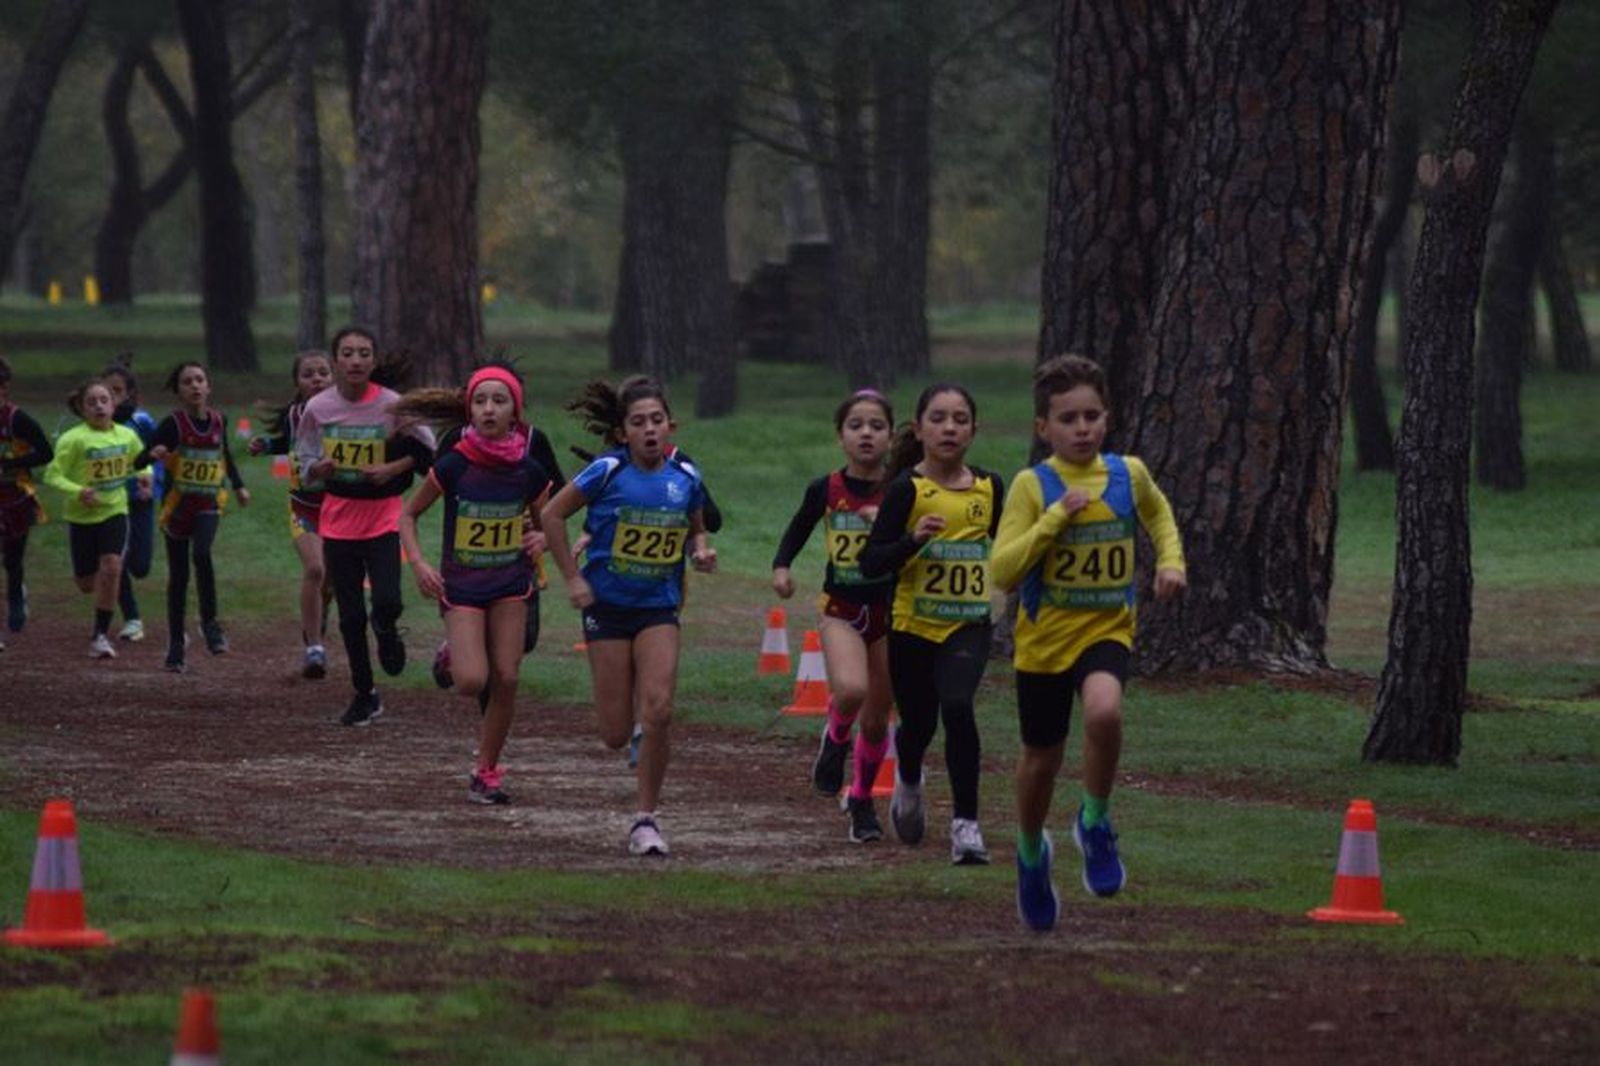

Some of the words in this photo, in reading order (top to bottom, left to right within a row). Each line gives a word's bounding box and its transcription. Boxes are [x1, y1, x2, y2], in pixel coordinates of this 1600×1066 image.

[332, 442, 374, 465] 471
[92, 458, 124, 478] 210
[182, 461, 218, 481] 207
[468, 521, 513, 547] 211
[621, 529, 679, 558] 225
[835, 534, 872, 562] 22
[1055, 546, 1126, 582] 240
[924, 563, 985, 596] 203
